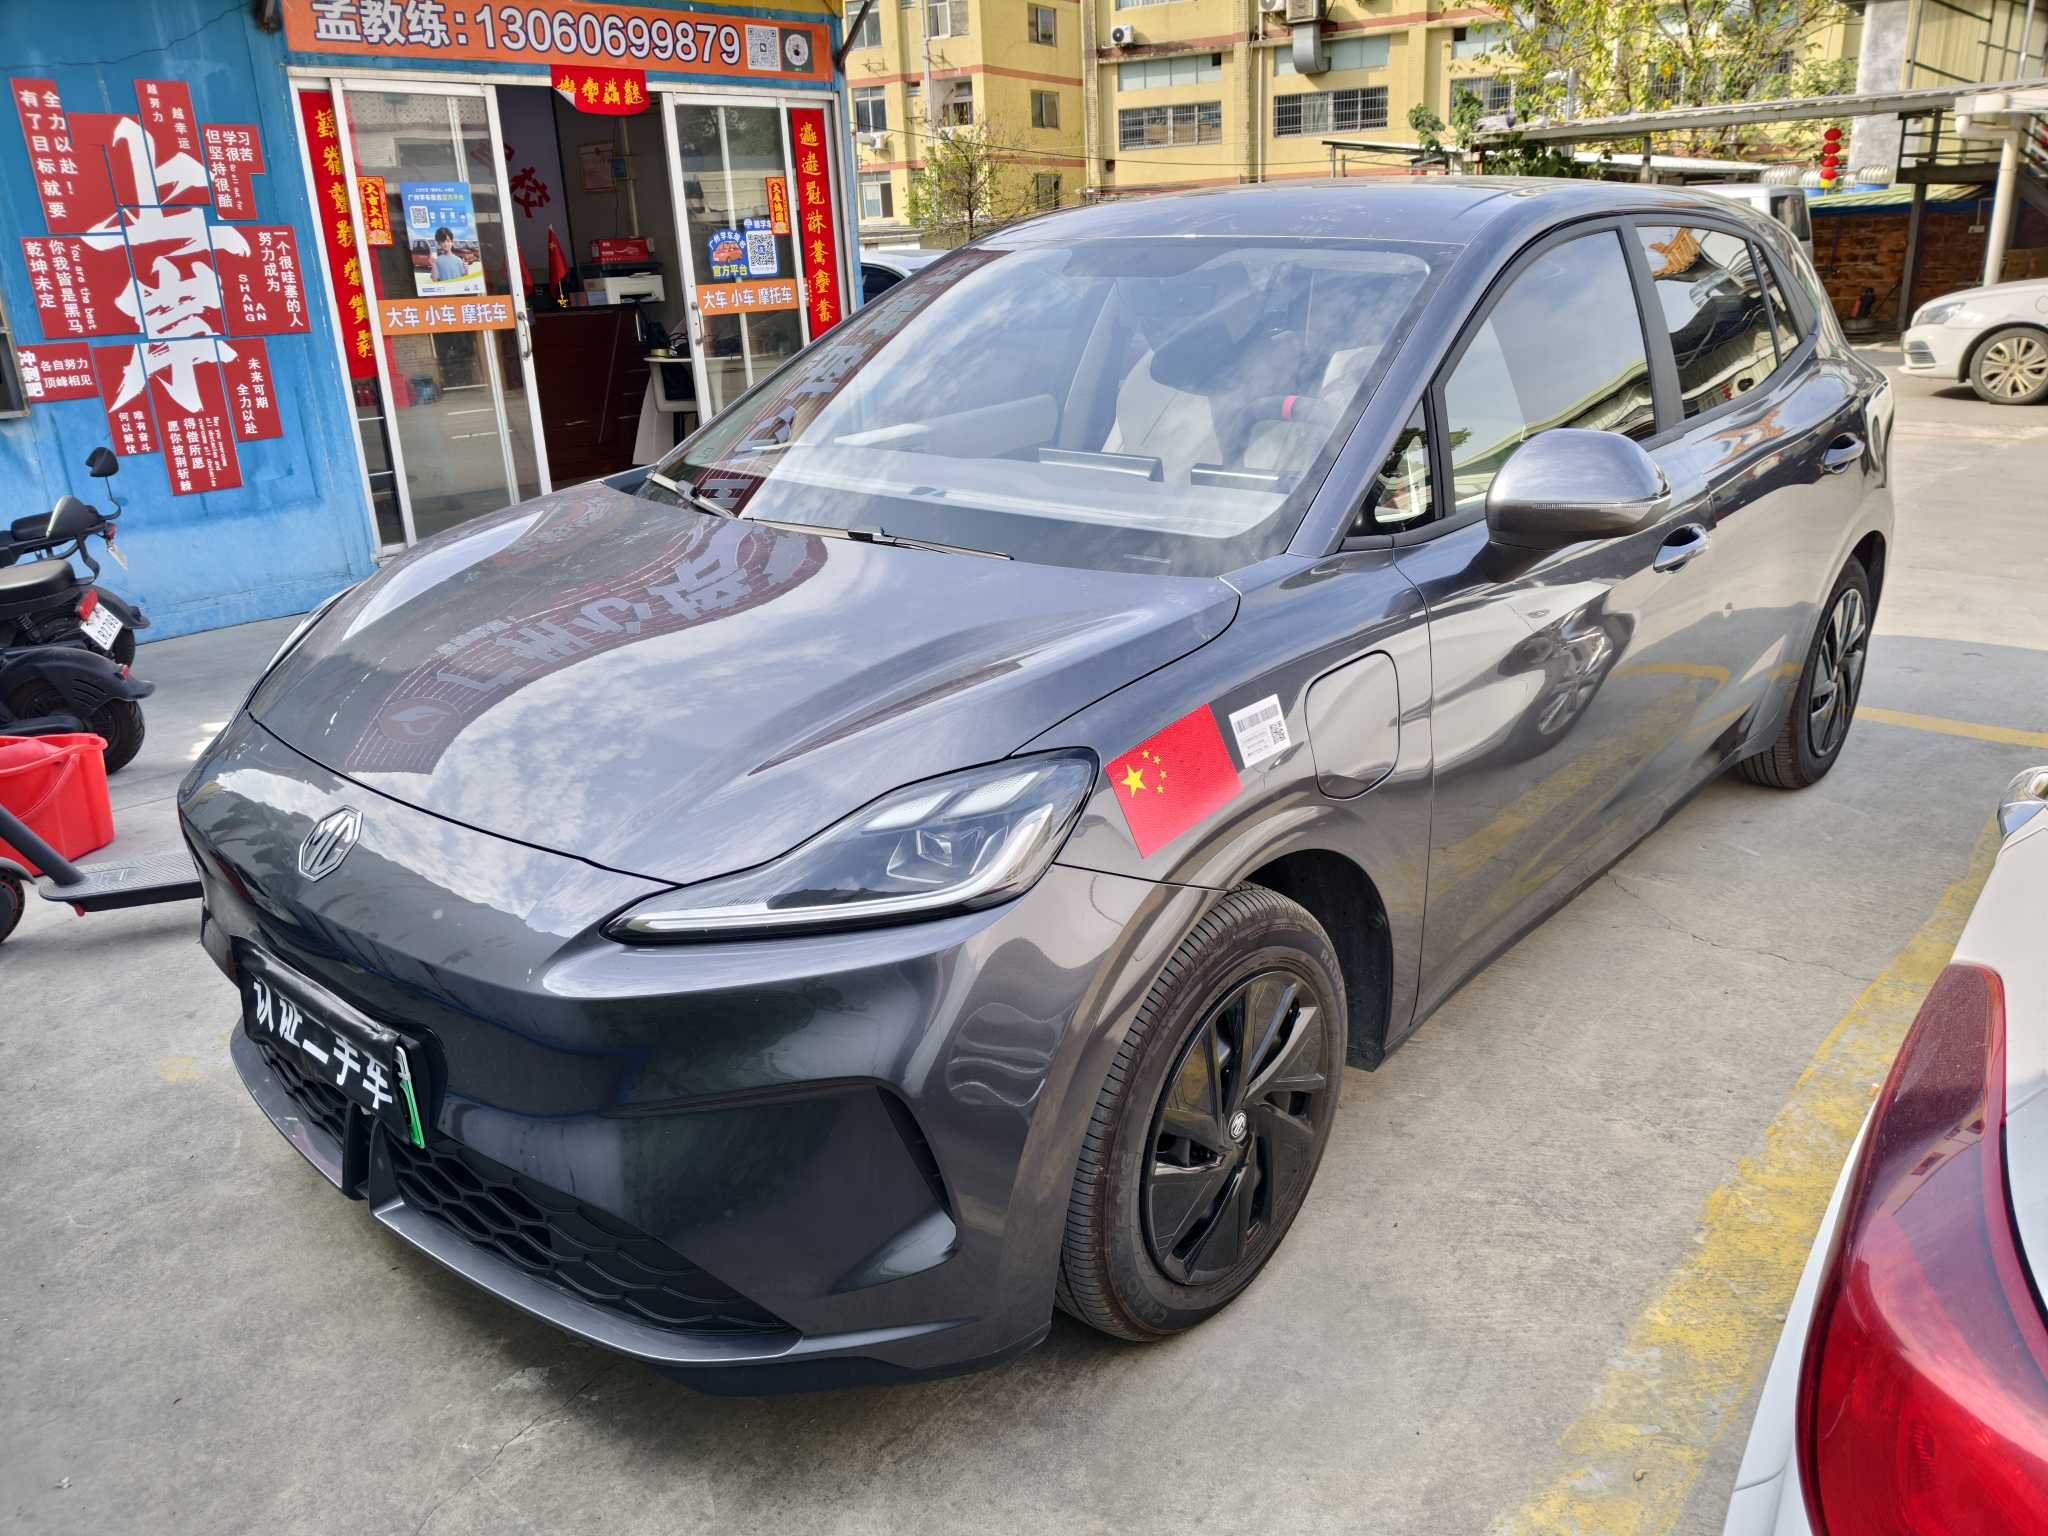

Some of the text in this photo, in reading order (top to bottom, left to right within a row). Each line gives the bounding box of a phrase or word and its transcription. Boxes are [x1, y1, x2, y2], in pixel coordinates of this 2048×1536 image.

[146, 83, 163, 122] 越努力
[171, 107, 191, 149] 越幸运
[19, 90, 67, 218] 有了目标就要
[42, 91, 79, 195] 全力以赴！
[205, 129, 233, 208] 但坚持很酷
[25, 241, 57, 308] 乾坤未定
[49, 240, 83, 333] 你我皆是黑马
[71, 244, 97, 330] You are the best
[80, 116, 251, 415] 上岸
[257, 232, 281, 292] 努力成为
[273, 231, 304, 327] 一个很哇塞的人
[238, 274, 268, 322] SHANG AN
[386, 302, 508, 328] 大车 小车 摩托车
[703, 290, 728, 309] 大车
[731, 288, 755, 307] 小车
[758, 286, 793, 305] 摩托车
[17, 351, 44, 397] 冲刺吧
[40, 359, 88, 372] 各自努力
[44, 375, 93, 388] 顶峰相见
[248, 357, 269, 409] 未来可期
[119, 412, 137, 454] 何以解忧
[236, 384, 258, 435] 全力以赴
[168, 420, 193, 492] 愿你披荆斩棘
[184, 417, 206, 470] 得偿所愿
